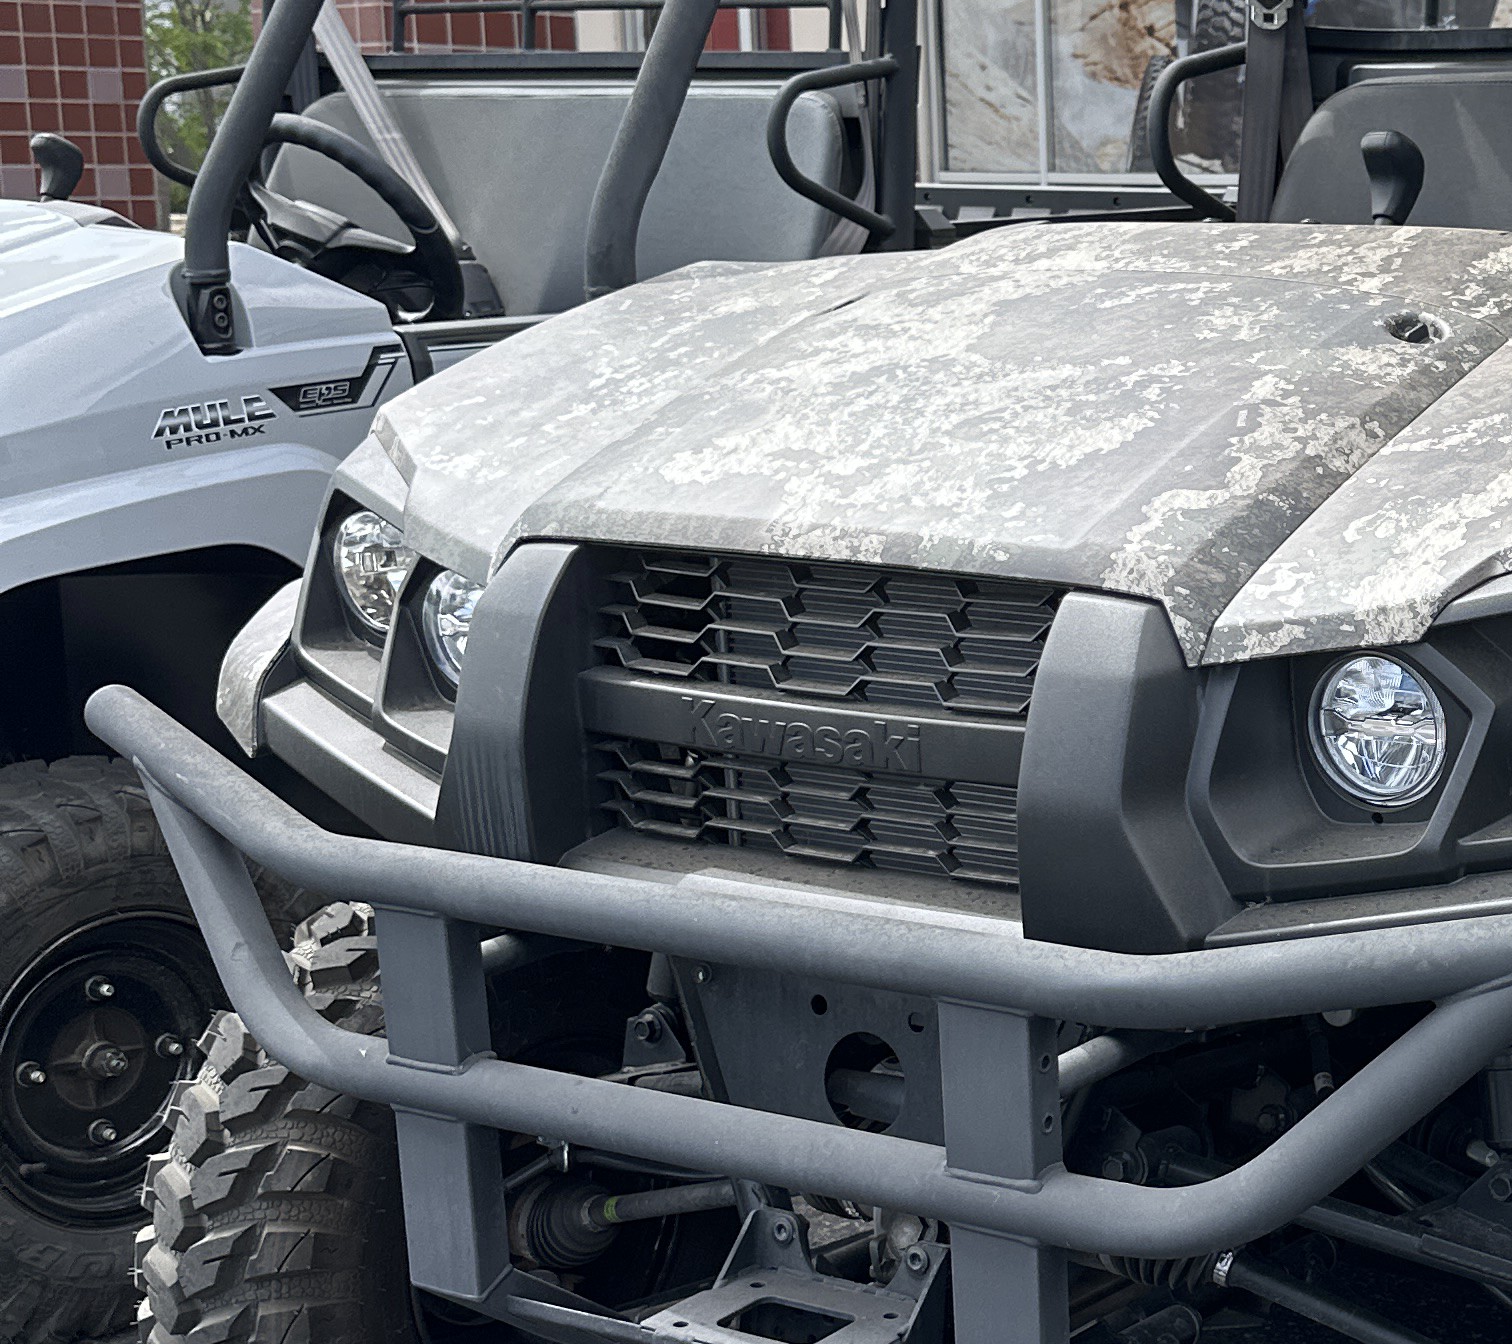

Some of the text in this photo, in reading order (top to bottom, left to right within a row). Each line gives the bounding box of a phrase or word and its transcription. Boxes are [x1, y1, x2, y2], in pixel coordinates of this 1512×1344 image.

[299, 381, 350, 405] EPS
[151, 394, 278, 440] MULE
[165, 424, 265, 450] PRO-MX
[681, 695, 923, 773] Kawasaki
